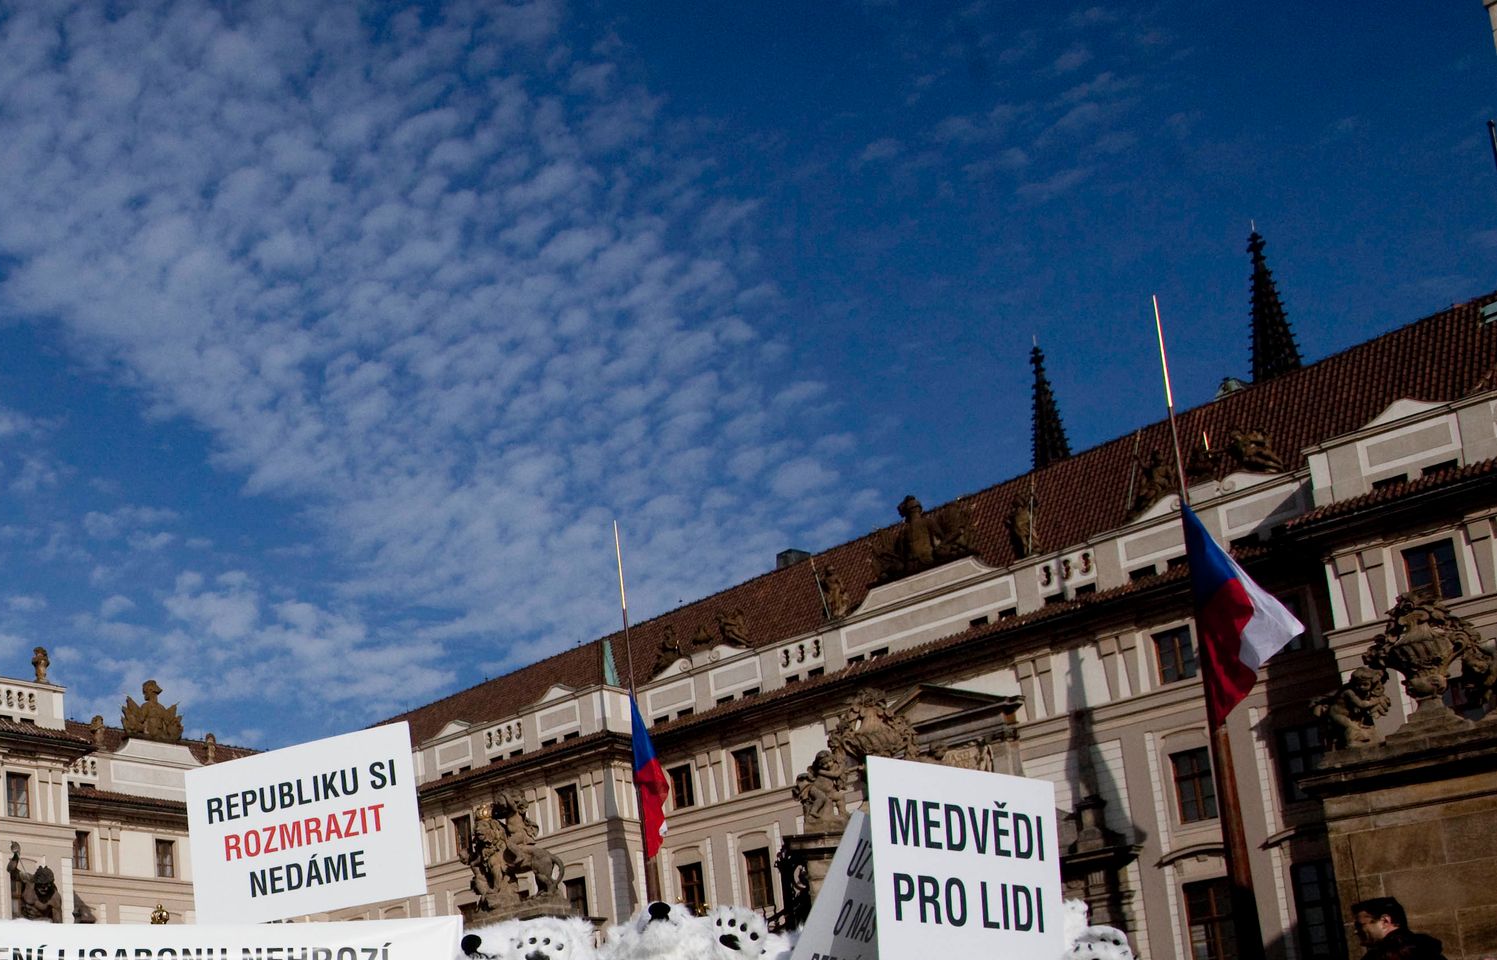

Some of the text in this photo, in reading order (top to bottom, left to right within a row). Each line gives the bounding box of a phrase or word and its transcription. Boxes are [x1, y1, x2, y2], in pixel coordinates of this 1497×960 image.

[206, 758, 397, 825] REPUBLIKU SI
[223, 803, 386, 862] ROZMRAZIT
[887, 796, 1045, 862] MEDVĚDI
[249, 849, 367, 899] NEDÁME
[892, 872, 1045, 934] PRO LIDI
[832, 898, 854, 937] O
